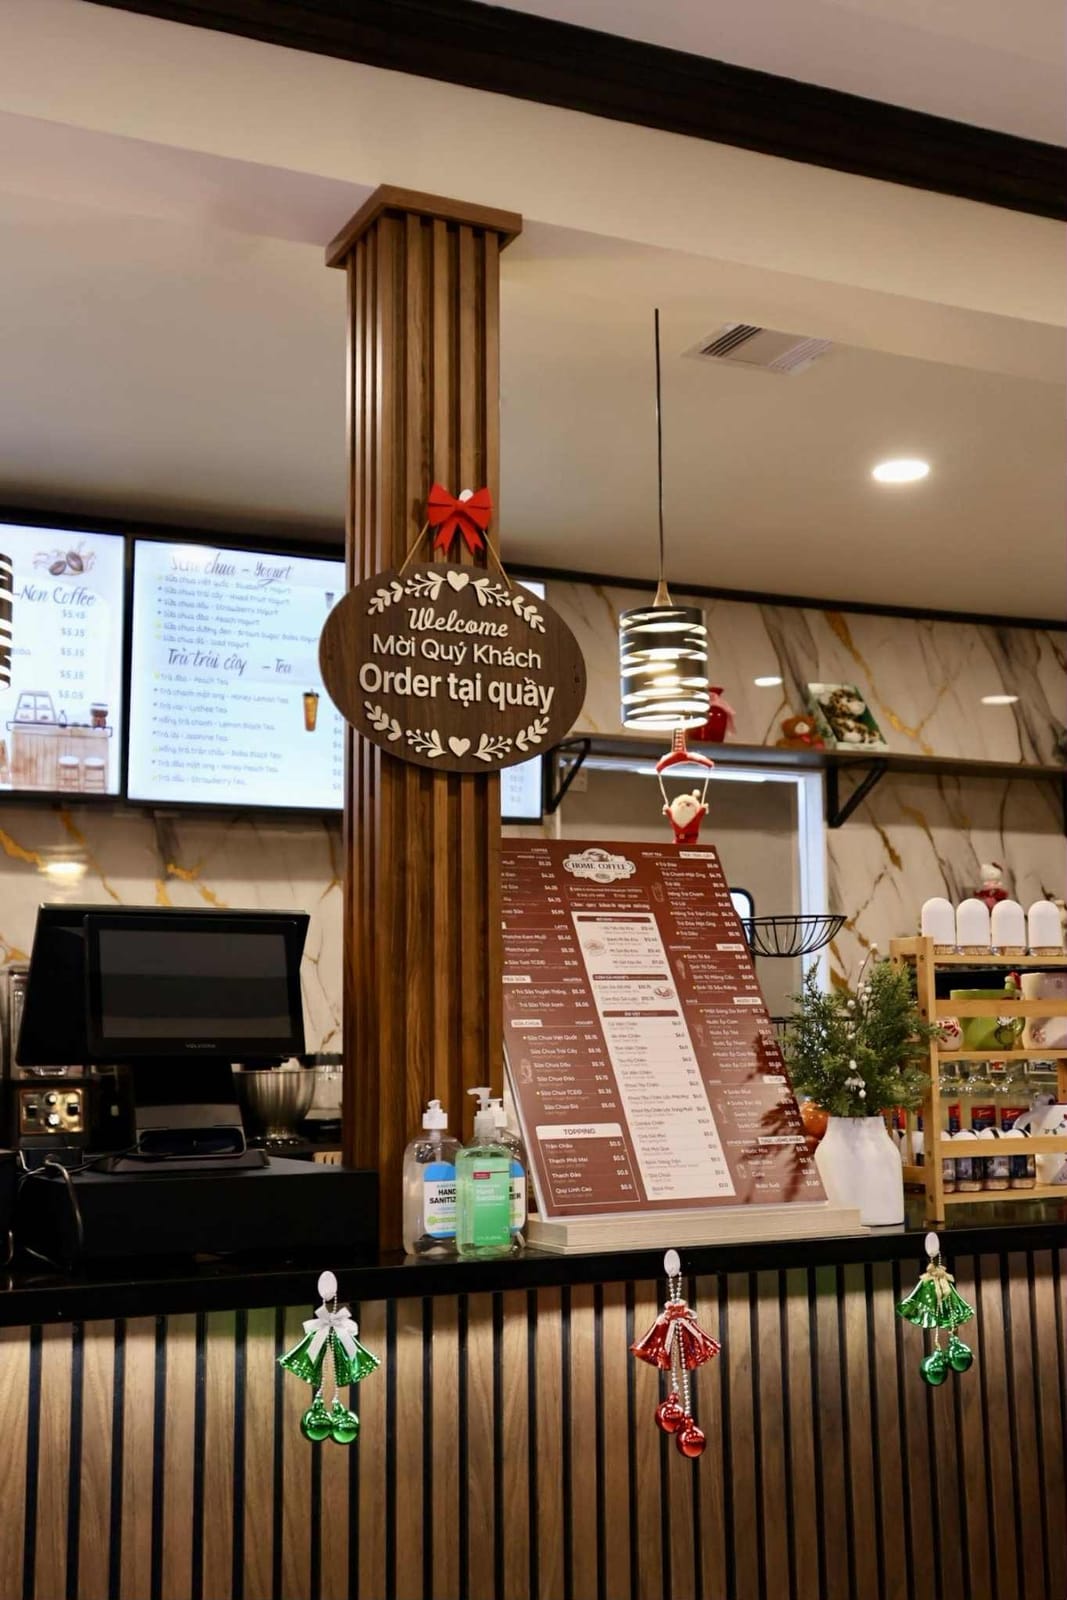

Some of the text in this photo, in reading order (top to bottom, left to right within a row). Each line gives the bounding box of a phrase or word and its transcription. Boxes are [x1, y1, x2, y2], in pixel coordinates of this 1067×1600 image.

[53, 586, 96, 606] Coffee
[408, 607, 509, 638] Welcome
[373, 634, 542, 669] Mời Quý Khách
[359, 663, 555, 714] Order tại quầy
